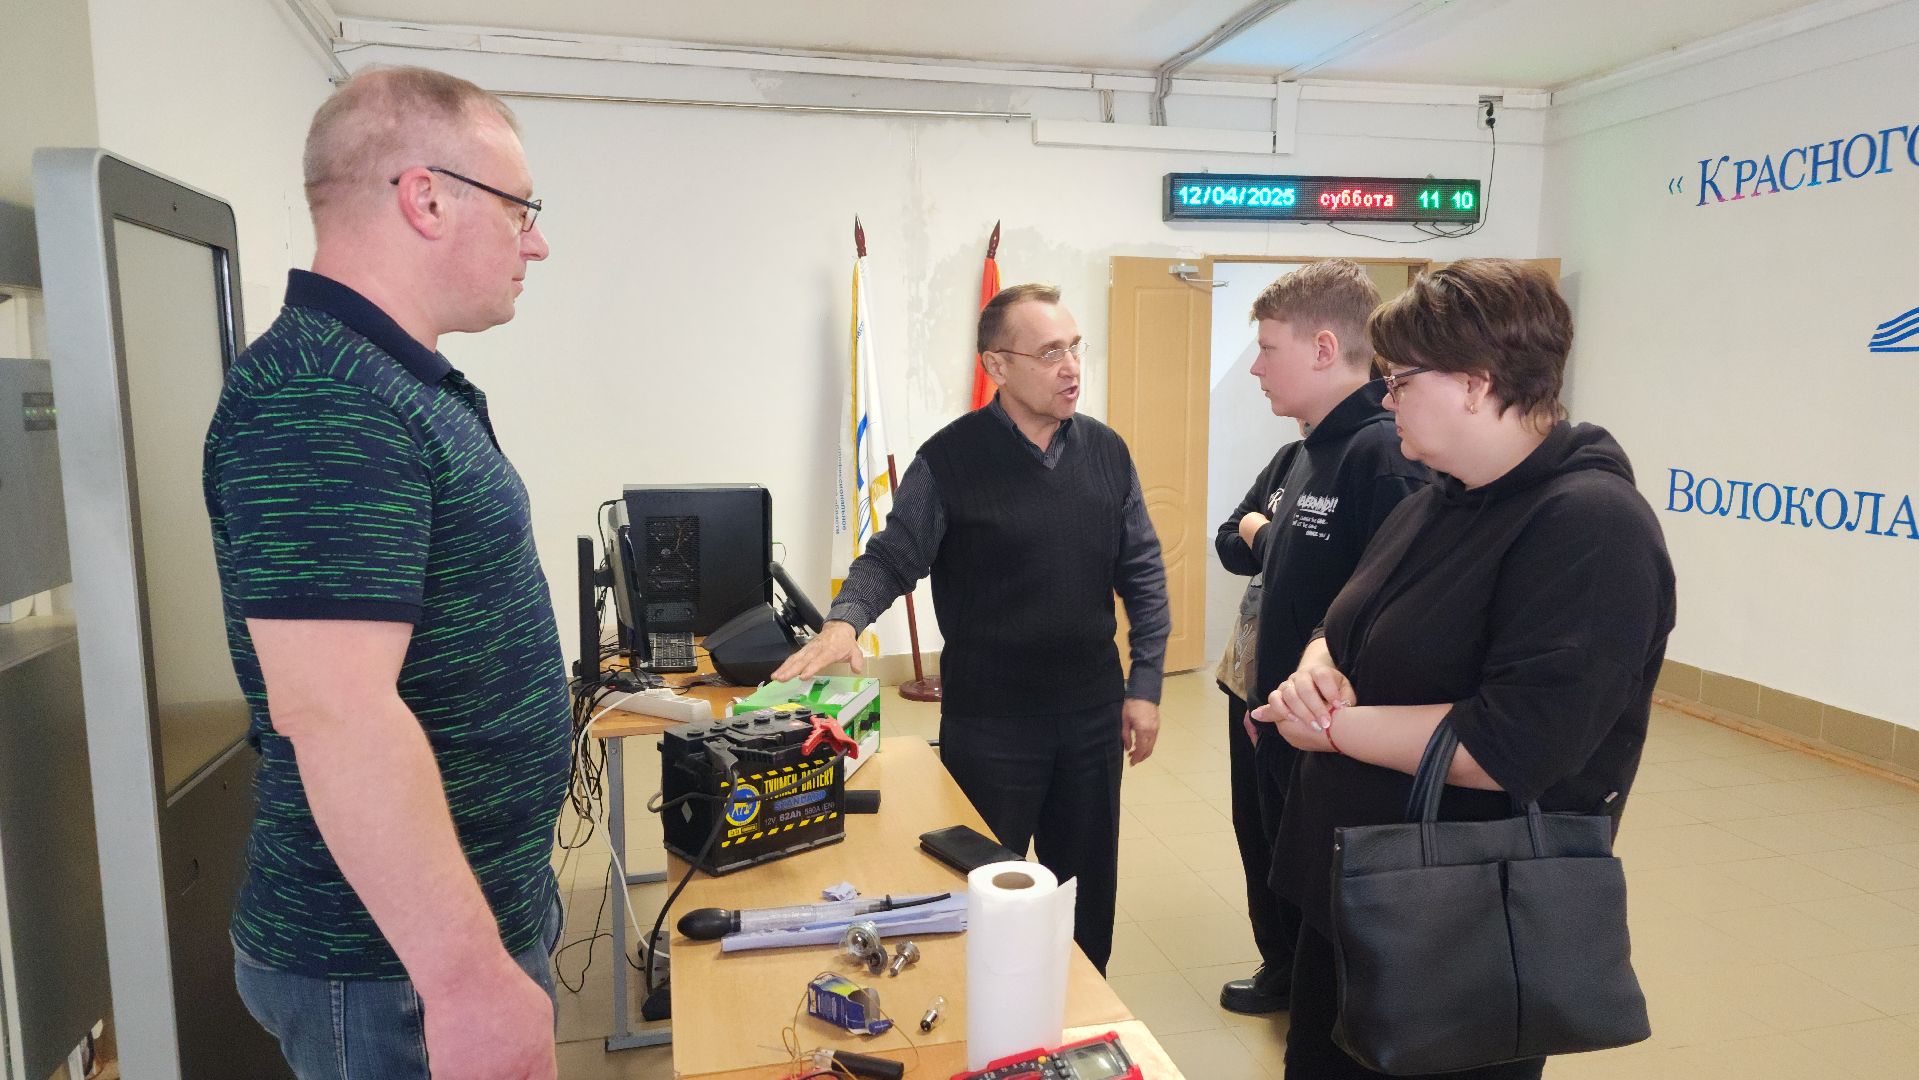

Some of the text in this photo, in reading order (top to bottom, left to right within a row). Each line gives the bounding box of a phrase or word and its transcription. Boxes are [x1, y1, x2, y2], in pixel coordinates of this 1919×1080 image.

[1178, 186, 1474, 211] 12/04/2025 суббота 11 10
[1664, 467, 1919, 541] ВОЛОКОЛА
[779, 810, 802, 822] 62Ah
